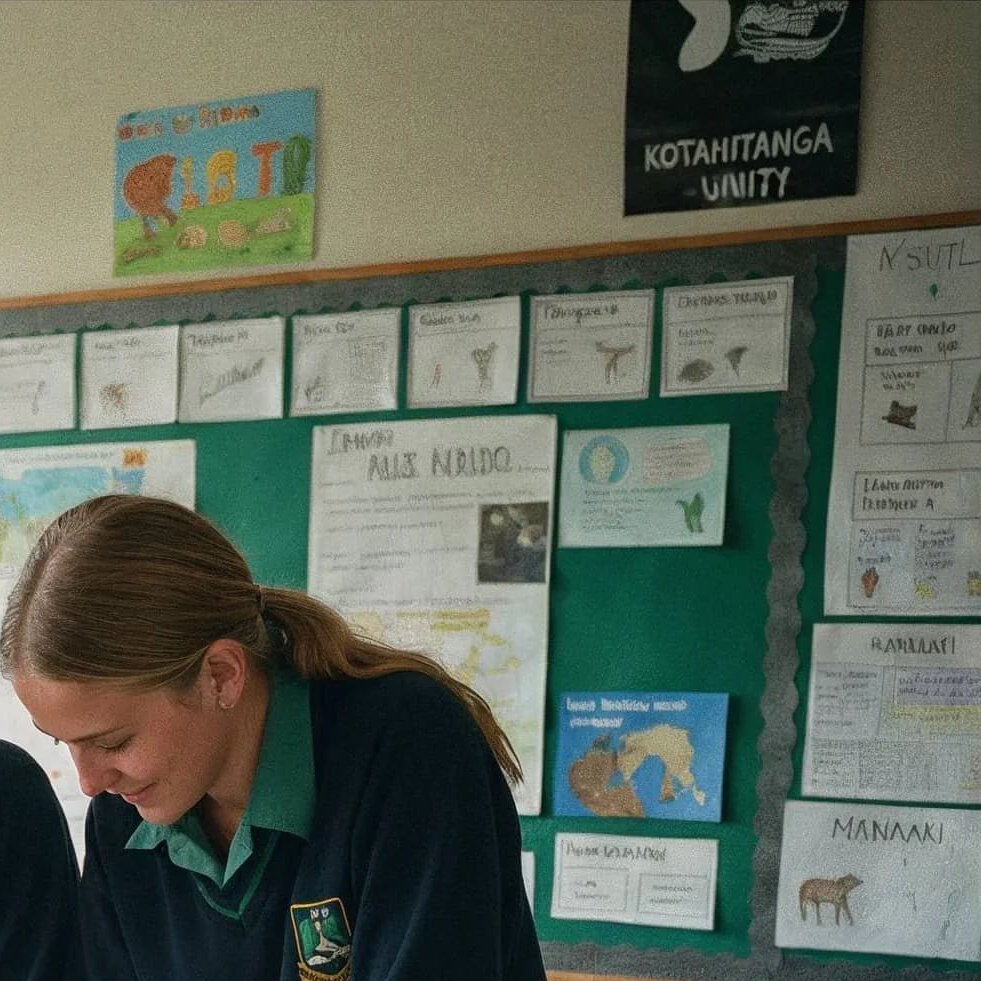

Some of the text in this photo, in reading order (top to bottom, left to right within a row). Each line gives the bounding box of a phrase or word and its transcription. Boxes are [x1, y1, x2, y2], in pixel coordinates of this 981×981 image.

[642, 122, 834, 173] KOTAHITANGA
[700, 166, 792, 202] UNITY
[831, 815, 944, 845] MANAAKI
